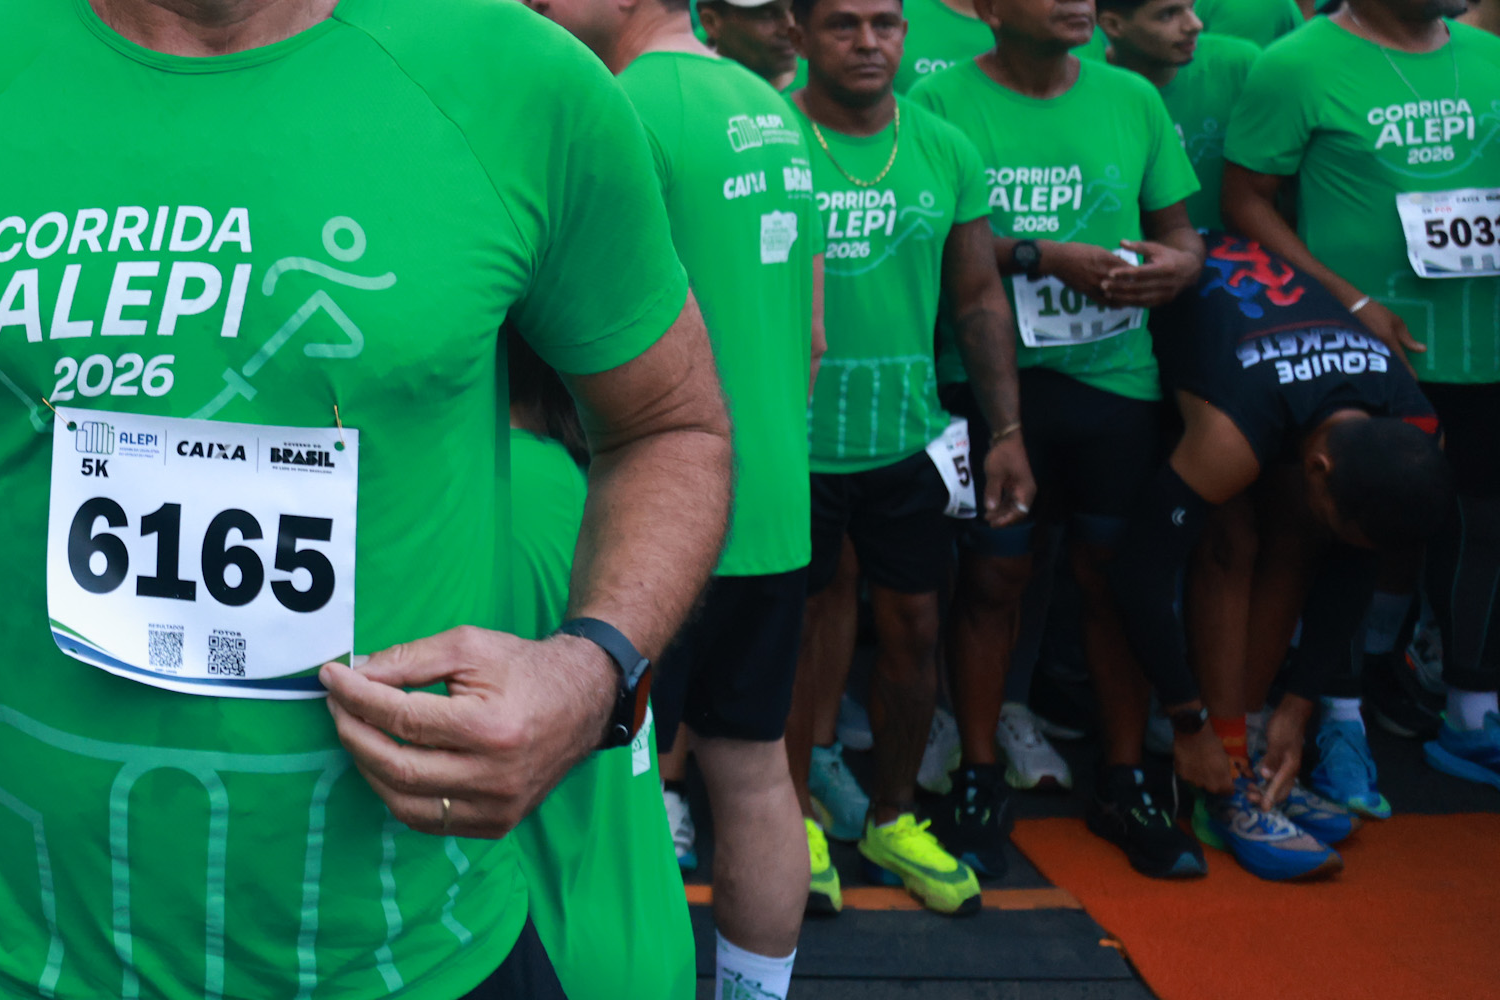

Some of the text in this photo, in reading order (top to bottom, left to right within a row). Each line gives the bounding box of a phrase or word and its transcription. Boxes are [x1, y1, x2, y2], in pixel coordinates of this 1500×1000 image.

[1367, 99, 1472, 125] CORRIDA
[1375, 114, 1475, 150] ALEPI
[1407, 146, 1455, 164] 2026
[815, 189, 897, 211] ORRIDA
[988, 184, 1083, 212] ALEPI
[827, 209, 897, 239] LEPI
[1012, 216, 1060, 232] 2026
[825, 241, 871, 259] 2026
[49, 352, 176, 403] 2026
[1275, 351, 1388, 384] EQUIPE
[119, 431, 158, 447] ALEPI
[176, 440, 247, 462] CAIXA
[270, 447, 335, 468] BRASIL
[81, 458, 109, 478] 5K
[67, 496, 336, 613] 6165
